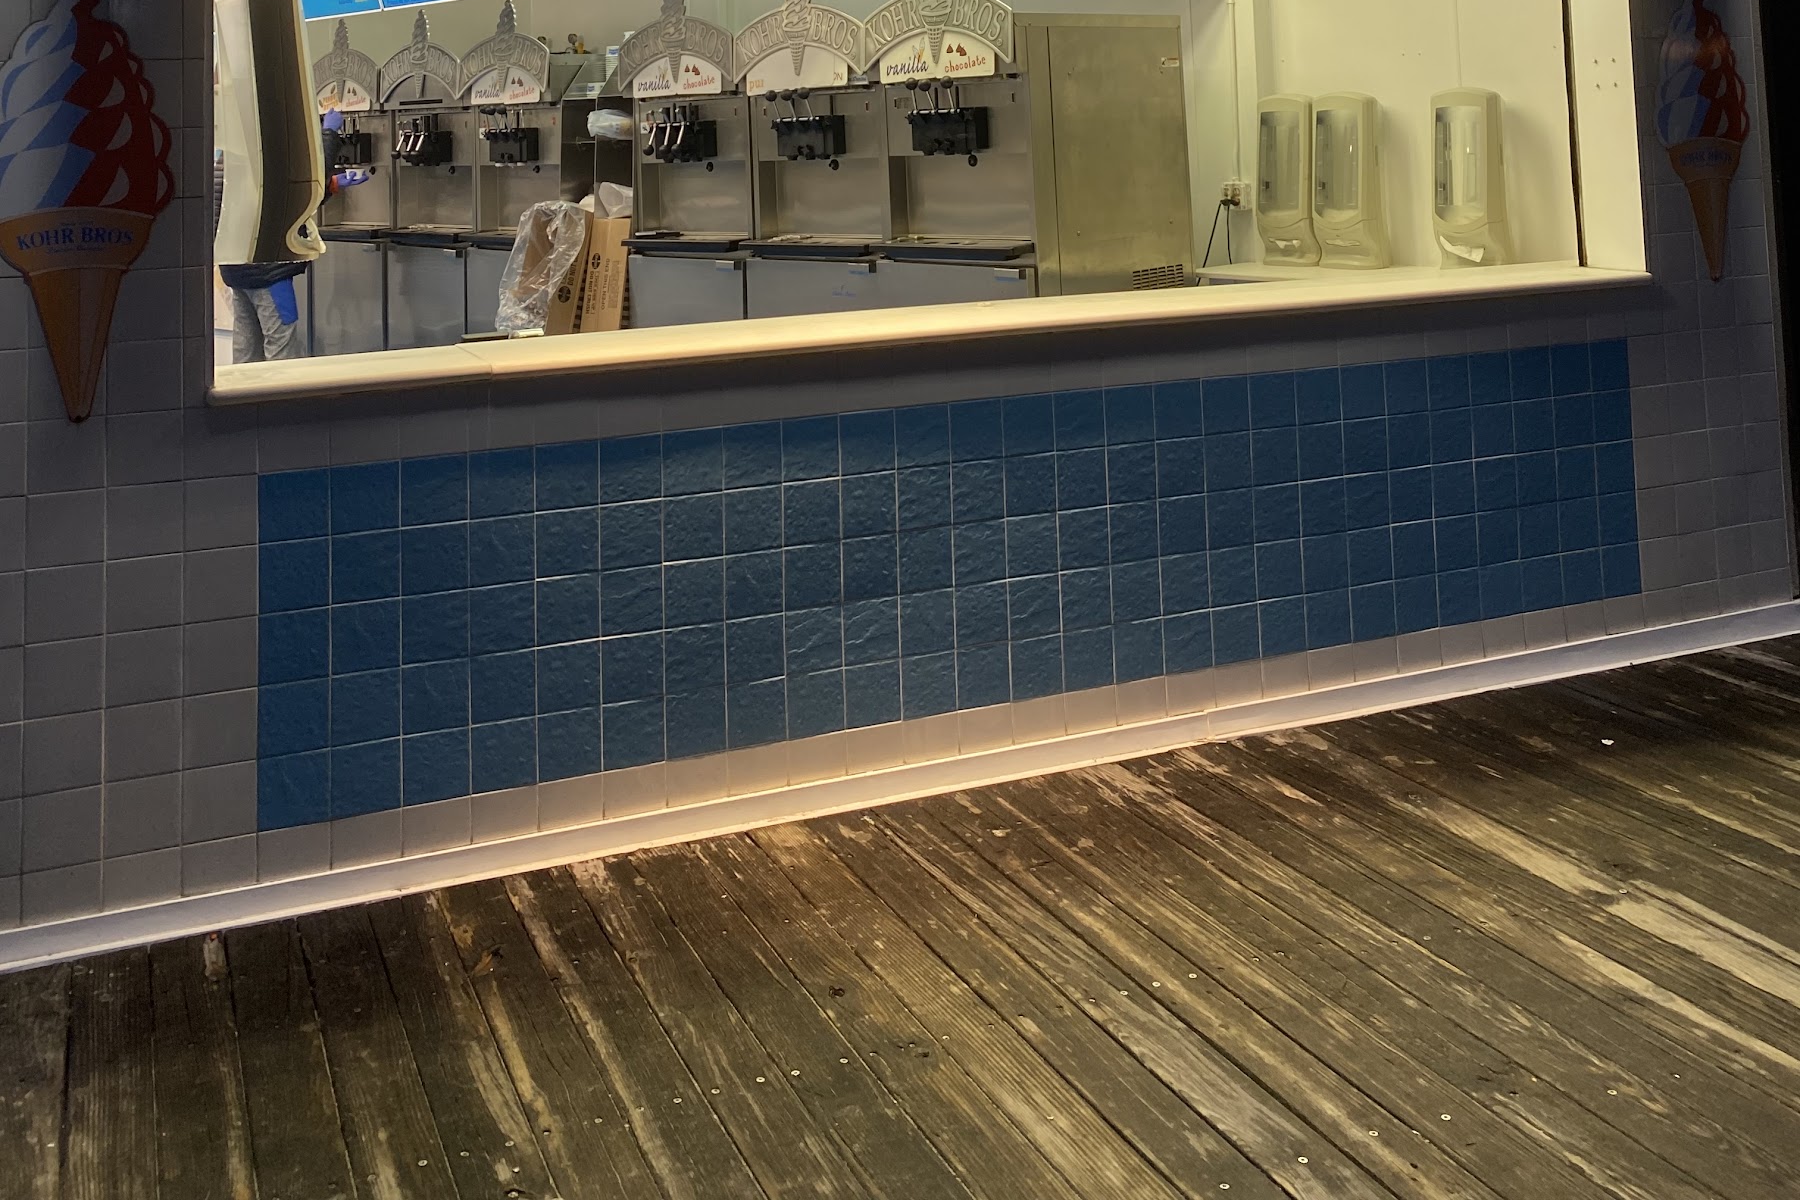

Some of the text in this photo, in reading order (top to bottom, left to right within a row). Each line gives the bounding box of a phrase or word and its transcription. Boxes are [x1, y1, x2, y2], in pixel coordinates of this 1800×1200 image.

[621, 21, 728, 74] KOHR BROS
[736, 11, 857, 64] KOHR BROS
[462, 41, 496, 78] KOHR
[886, 55, 986, 77] vanilla chocolate
[474, 86, 535, 100] vanilla chocolate
[637, 74, 716, 92] vanilla chocolate
[17, 228, 75, 250] KOHR
[81, 227, 134, 244] BROS
